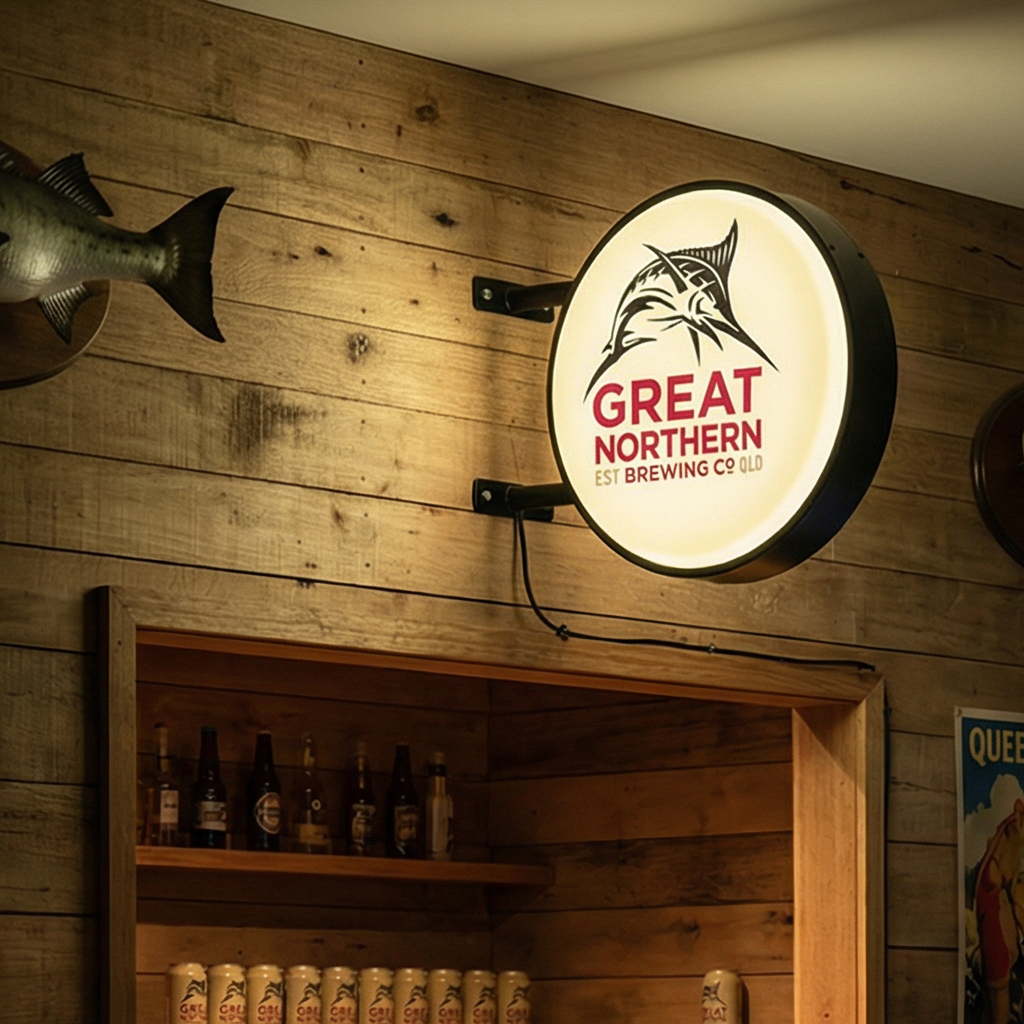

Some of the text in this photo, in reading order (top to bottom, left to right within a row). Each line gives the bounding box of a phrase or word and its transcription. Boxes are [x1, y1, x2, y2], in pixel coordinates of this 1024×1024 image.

[593, 367, 762, 428] GREAT
[595, 419, 762, 464] NORTHERN
[594, 468, 620, 487] EST
[624, 459, 709, 484] BREWING
[738, 453, 764, 474] QLD
